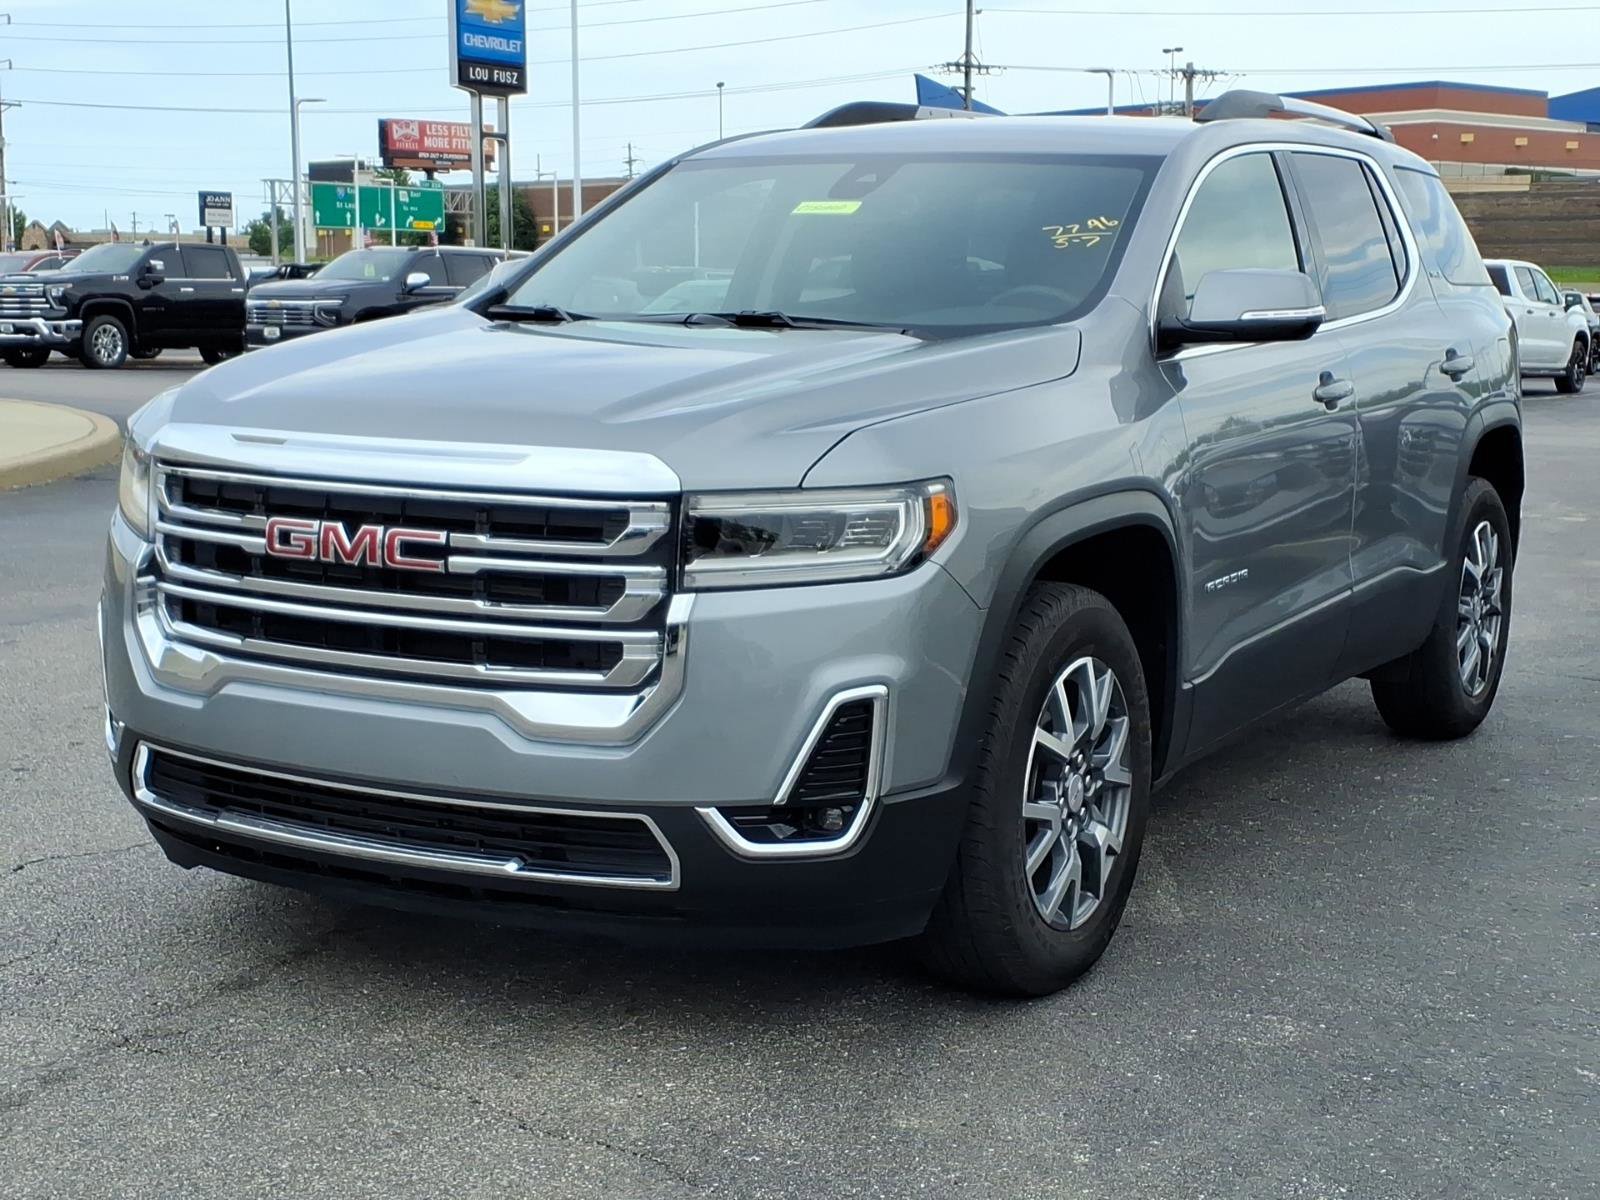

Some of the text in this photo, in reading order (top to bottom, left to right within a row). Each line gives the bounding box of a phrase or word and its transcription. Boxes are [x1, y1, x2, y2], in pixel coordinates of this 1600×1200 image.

[463, 32, 522, 53] CHEVROLET
[469, 66, 519, 84] LOU FUSZ
[426, 124, 449, 136] LESS
[424, 136, 450, 149] MORE
[265, 516, 447, 574] GMC
